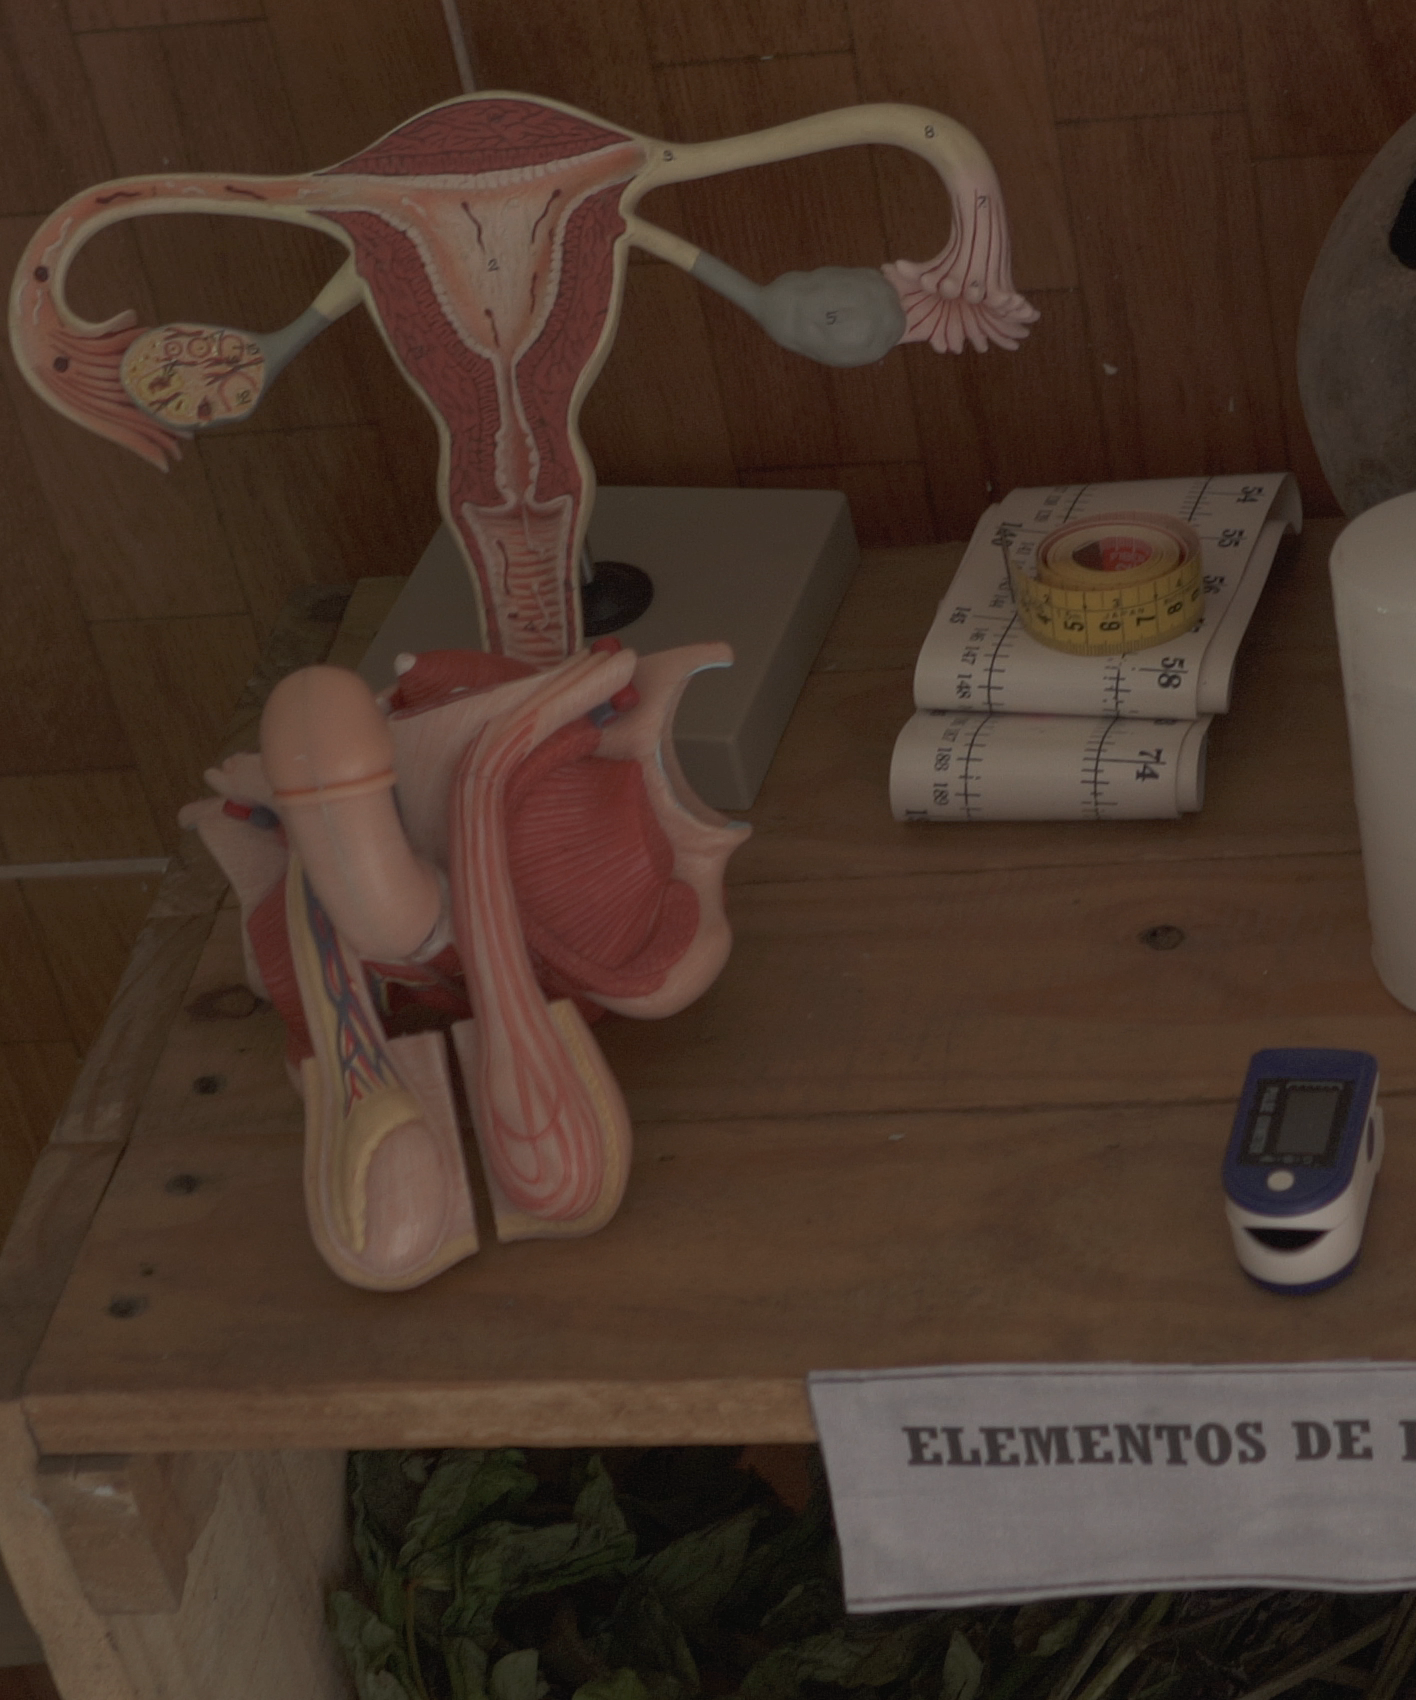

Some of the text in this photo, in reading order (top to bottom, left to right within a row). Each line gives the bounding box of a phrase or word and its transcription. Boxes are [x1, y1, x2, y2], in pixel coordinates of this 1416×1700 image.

[924, 125, 934, 139] 8
[487, 258, 500, 272] 2
[826, 311, 838, 325] 5
[1236, 486, 1264, 504] 54
[1217, 528, 1245, 548] 55
[949, 606, 972, 624] 145
[1063, 621, 1085, 633] 5
[1099, 620, 1121, 632] 6
[1136, 614, 1156, 627] 7
[1167, 601, 1183, 615] 8
[960, 646, 980, 666] 147
[1158, 656, 1185, 689] 58
[956, 673, 973, 700] 148
[934, 747, 952, 772] 188
[1137, 748, 1163, 782] 74
[932, 782, 950, 806] 189
[902, 1420, 1267, 1467] ELEMENTOS
[1293, 1419, 1374, 1462] DE
